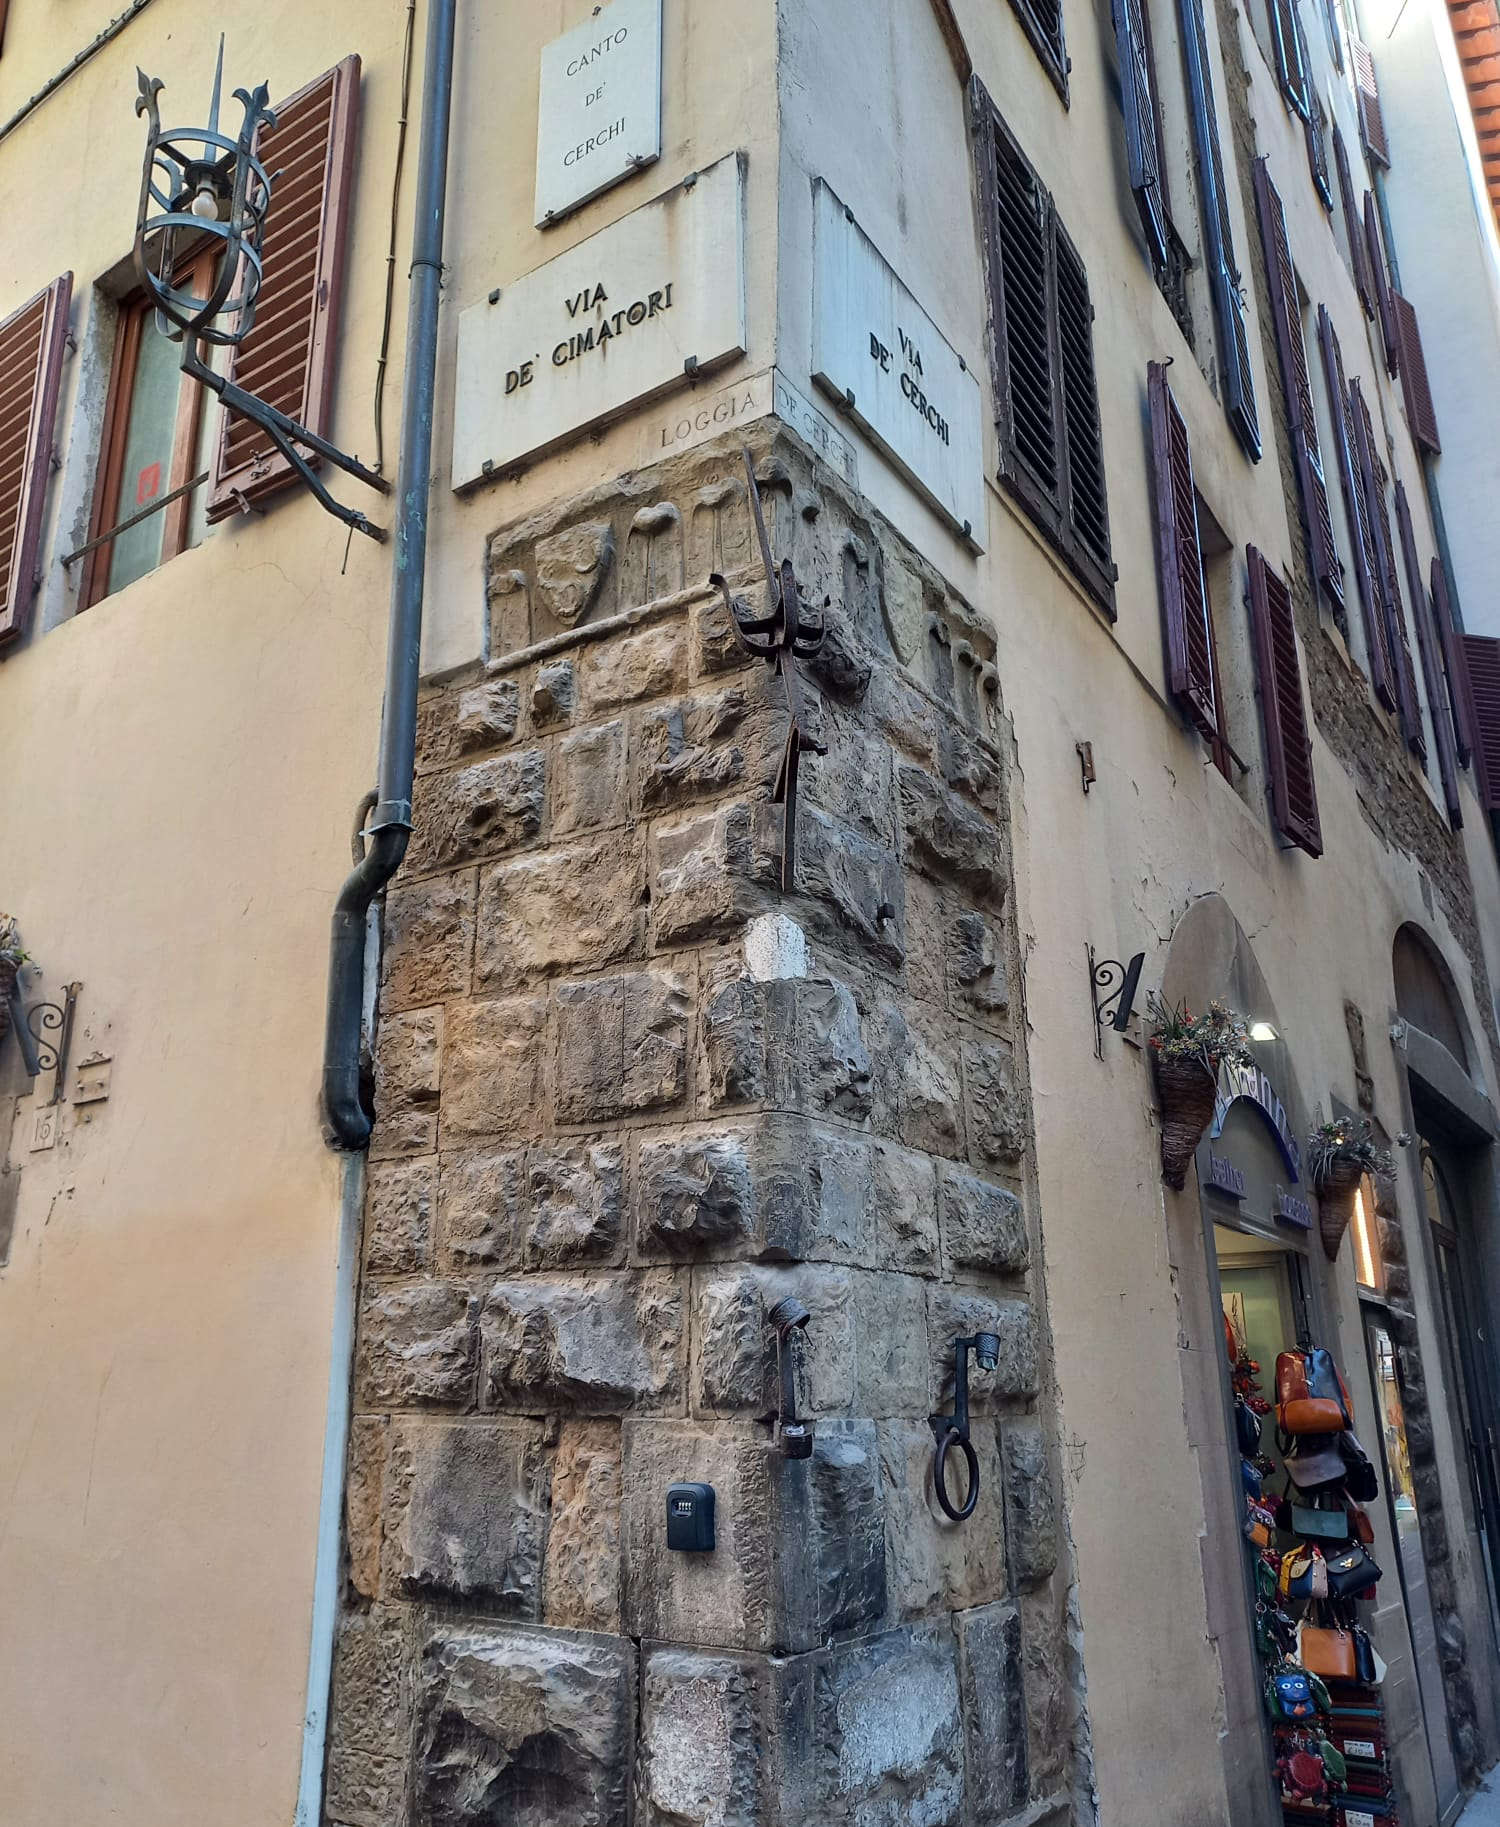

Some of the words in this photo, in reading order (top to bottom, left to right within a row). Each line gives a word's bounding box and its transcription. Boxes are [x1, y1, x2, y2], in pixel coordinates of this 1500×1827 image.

[566, 27, 628, 77] CANTO
[585, 82, 606, 107] DE'
[563, 117, 625, 167] CERCHI
[551, 283, 673, 367] CIMATORI
[565, 282, 608, 318] VIA
[897, 327, 923, 376] VIA
[869, 332, 894, 374] DE'
[900, 372, 949, 446] CERCHI
[659, 391, 756, 448] LOGGIA
